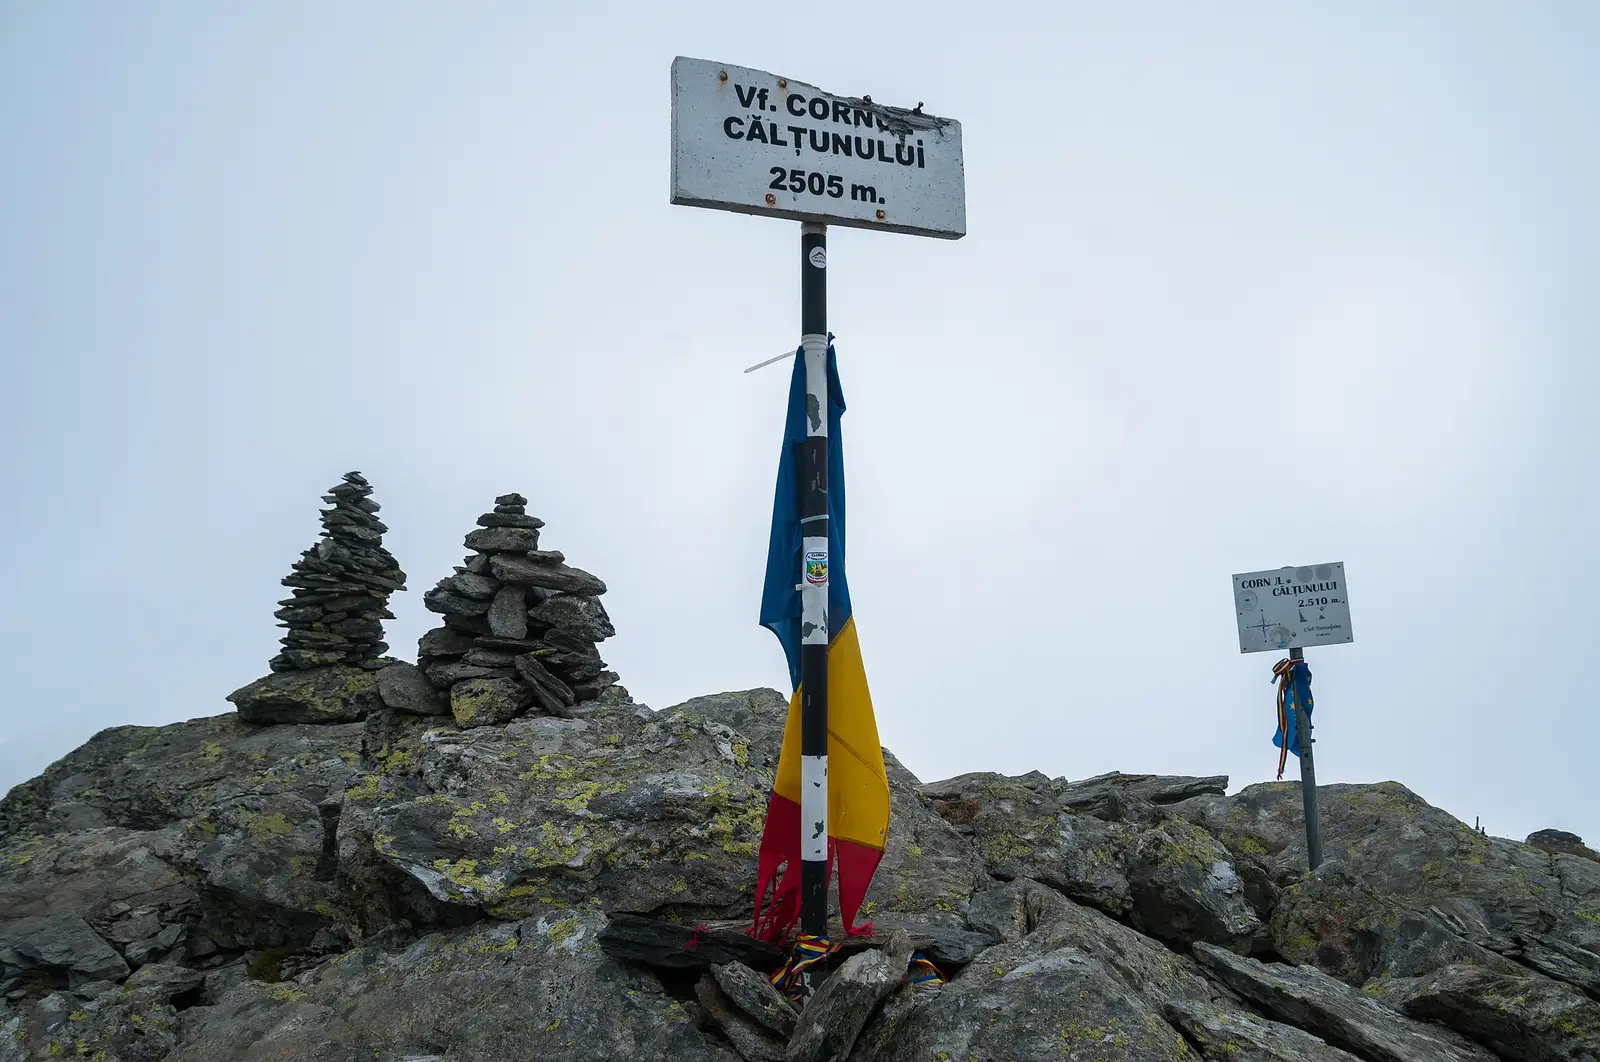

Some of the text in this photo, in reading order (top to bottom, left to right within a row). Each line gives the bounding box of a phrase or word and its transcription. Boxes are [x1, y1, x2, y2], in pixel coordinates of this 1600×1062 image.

[734, 84, 914, 135] Vf. CORN
[769, 166, 886, 204] 2505 m.
[1298, 597, 1328, 608] 2.510
[1303, 625, 1315, 633] Club
